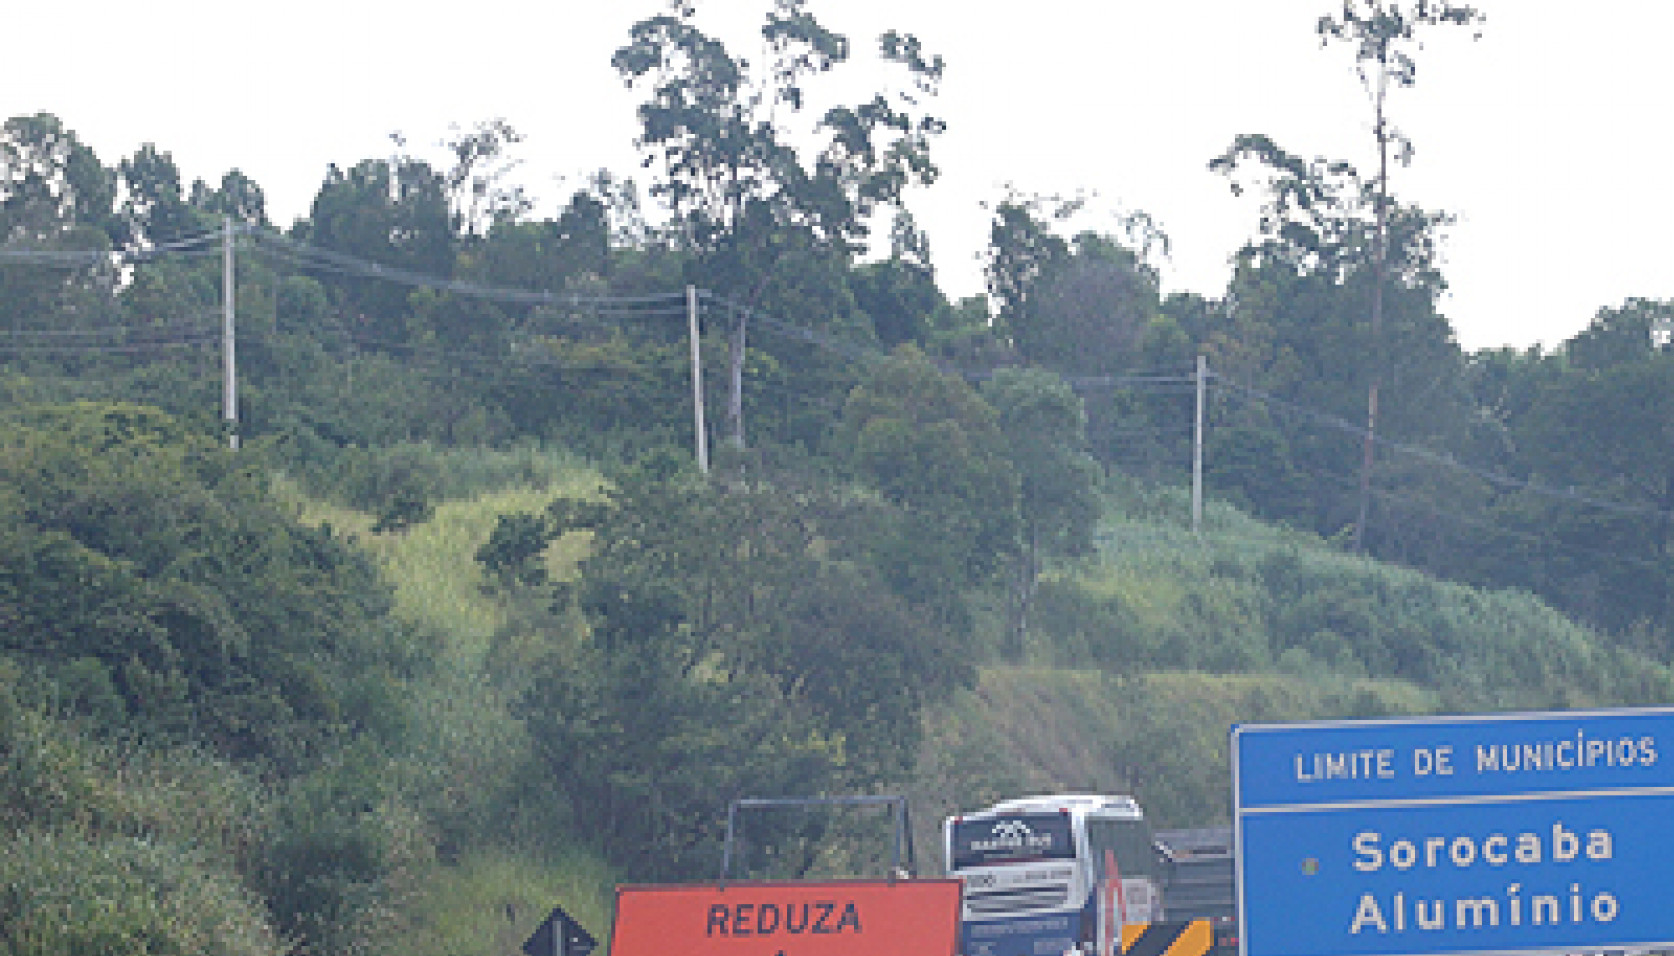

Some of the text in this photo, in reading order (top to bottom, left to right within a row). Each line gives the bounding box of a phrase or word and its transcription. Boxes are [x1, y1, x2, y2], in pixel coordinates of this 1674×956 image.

[1295, 729, 1658, 782] LIMITE DE MUNICÍPIOS
[1351, 821, 1614, 872] Sorocaba
[706, 902, 863, 937] REDUZA
[1349, 883, 1620, 934] Alumínio
